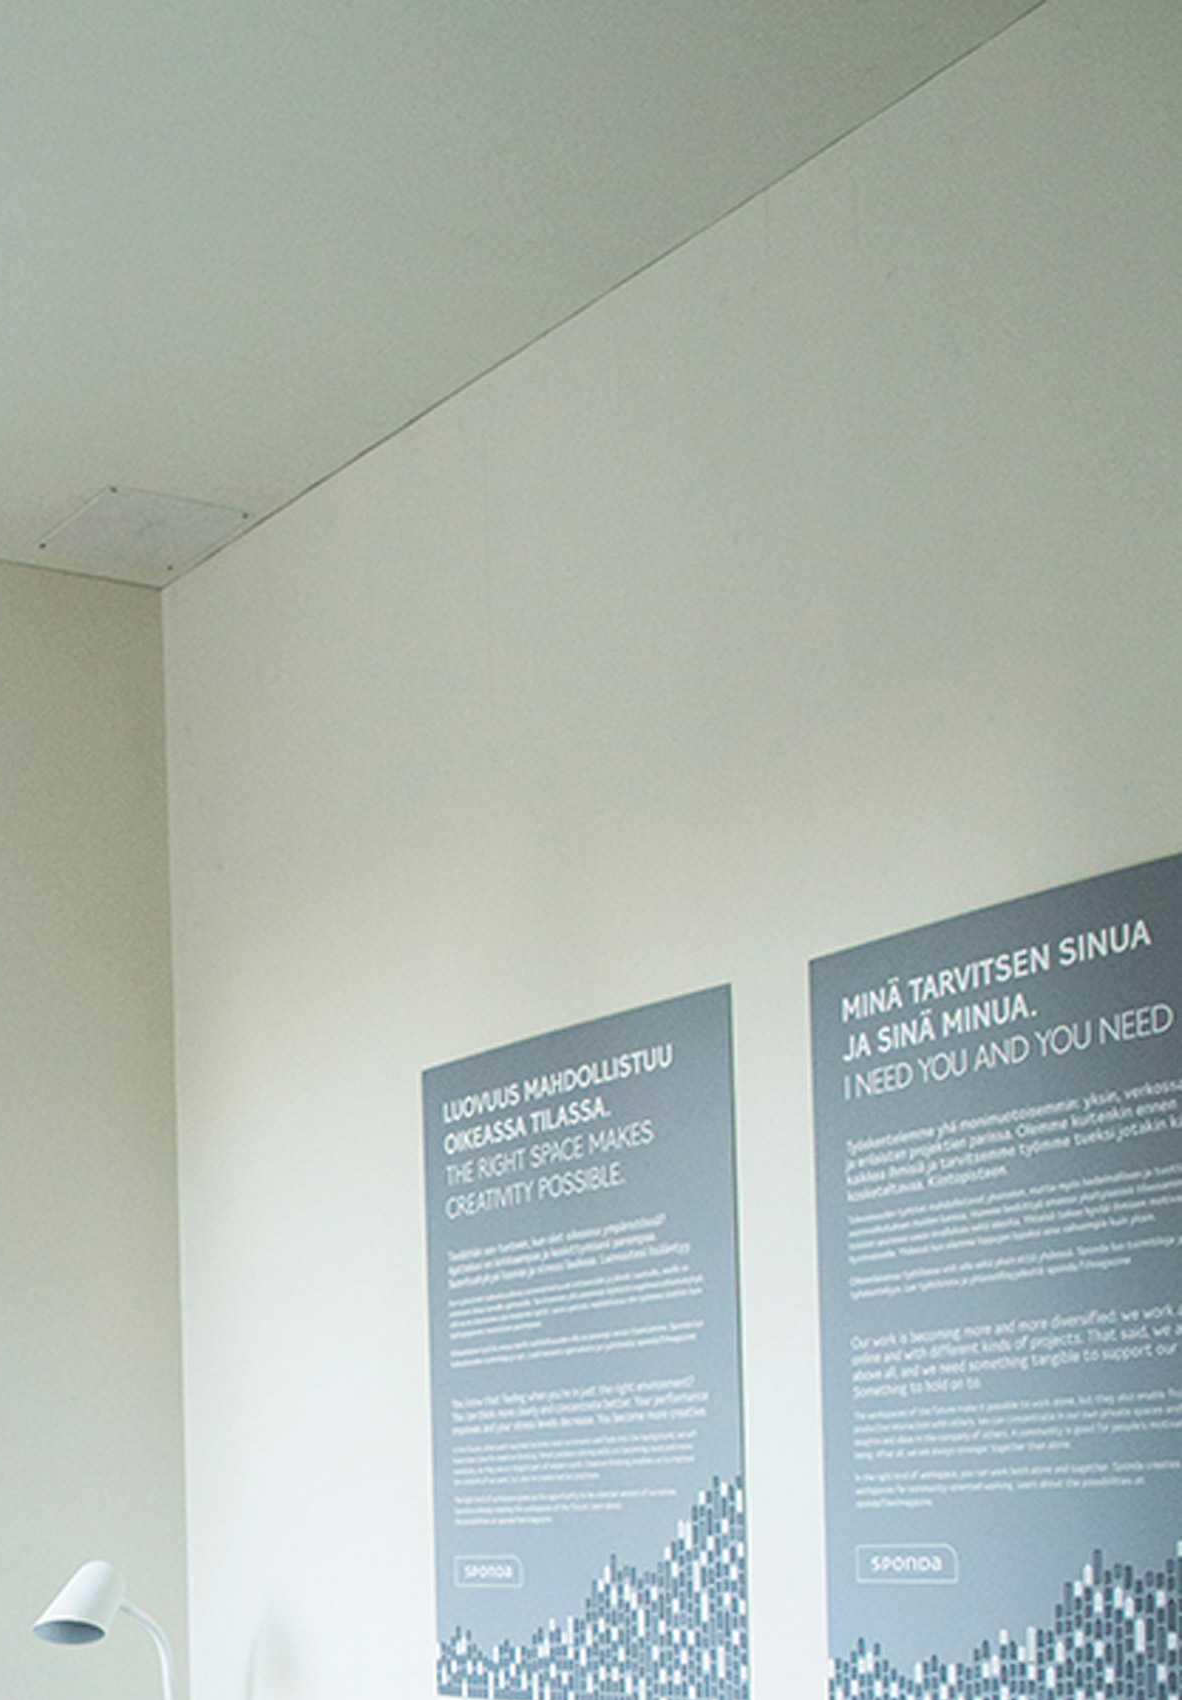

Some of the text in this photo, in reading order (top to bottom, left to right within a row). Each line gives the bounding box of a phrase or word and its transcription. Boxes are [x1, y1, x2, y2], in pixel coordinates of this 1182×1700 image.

[842, 920, 1150, 1021] MINÄ TARVITSEN SINUA
[843, 994, 1036, 1061] JA SINÄ MINUA.
[844, 1003, 1173, 1099] I NEED YOU AND YOU NEED
[443, 1045, 672, 1123] LUOVUUS MAHDOLLISTUU
[444, 1097, 610, 1154] OIKEASSA TILASSA.
[446, 1119, 653, 1185] THE RIGHT SPACE MAKES
[445, 1162, 624, 1219] CREATIVITY POSSIBLE.
